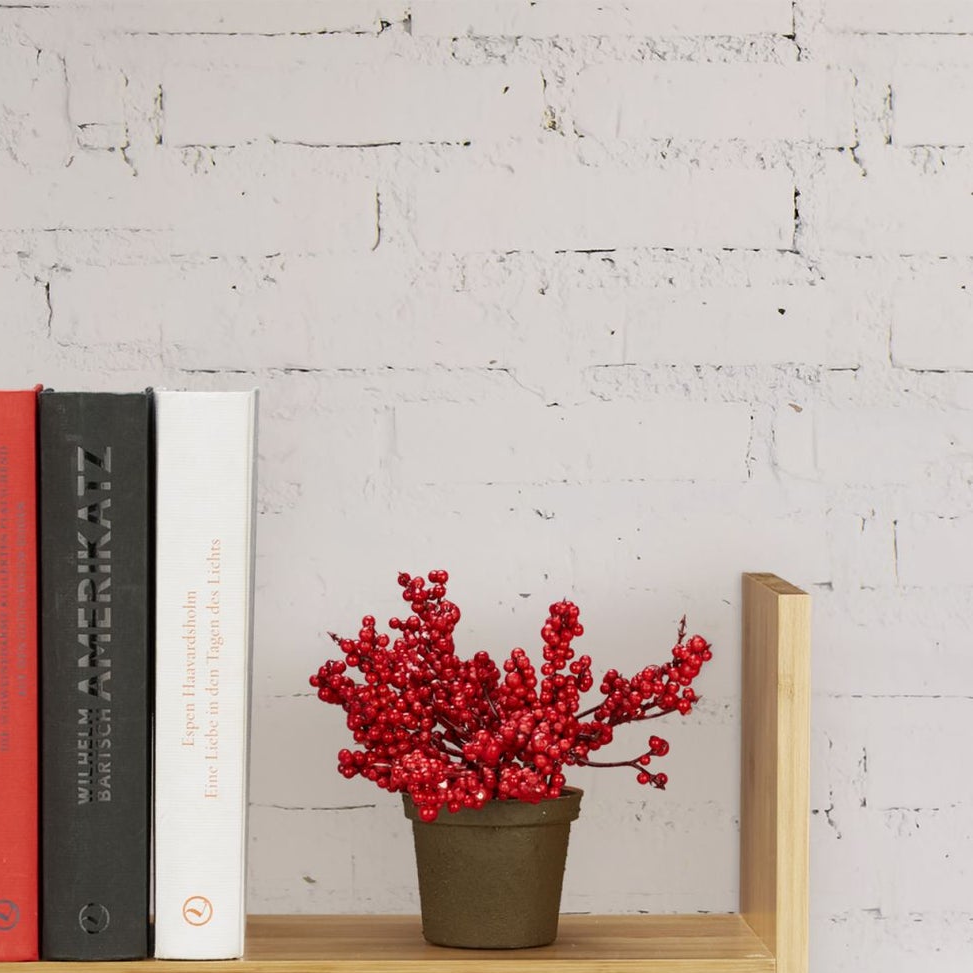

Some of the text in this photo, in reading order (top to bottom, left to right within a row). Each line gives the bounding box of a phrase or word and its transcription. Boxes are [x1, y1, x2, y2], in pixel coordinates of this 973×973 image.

[77, 446, 113, 702] AMERIKATZ
[181, 591, 200, 747] Espen Haavardsholm
[204, 538, 224, 799] Eine Liebe in den Tagen des Lichts
[77, 709, 93, 805] WILHELM
